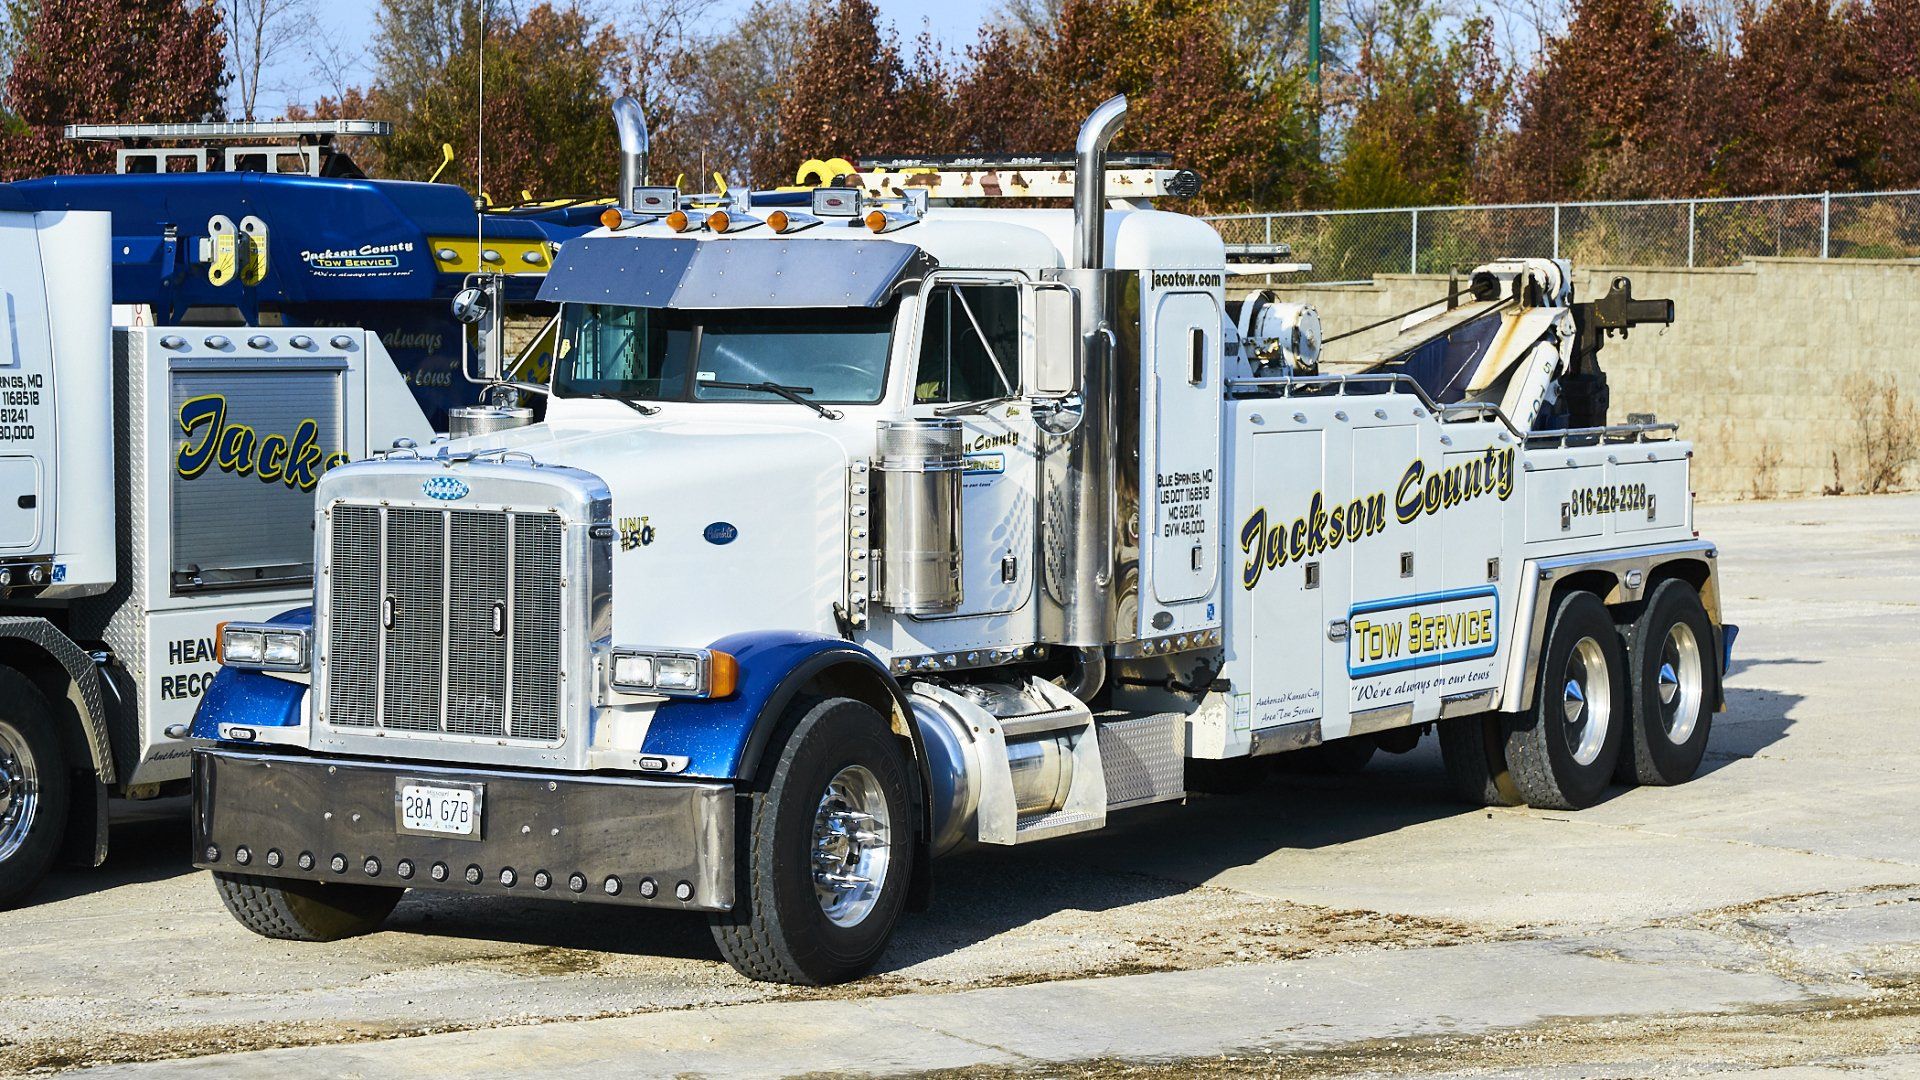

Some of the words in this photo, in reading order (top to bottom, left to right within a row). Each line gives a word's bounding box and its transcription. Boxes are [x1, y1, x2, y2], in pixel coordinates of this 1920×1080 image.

[301, 249, 358, 262] Jackson
[359, 242, 414, 255] County
[317, 258, 342, 267] TOW
[344, 258, 393, 267] SERVICE
[1151, 269, 1221, 291] jacotow.com
[383, 329, 442, 353] always
[0, 376, 27, 390] INGS,
[27, 374, 43, 388] MO
[2, 391, 40, 405] 1168518
[176, 393, 350, 493] Jacks
[974, 432, 1019, 451] County
[1157, 473, 1173, 488] BLUE
[1202, 468, 1213, 482] MO
[1160, 489, 1170, 504] US
[1170, 488, 1185, 503] DOT
[1185, 486, 1210, 501] 1168518
[1572, 482, 1647, 517] 816-228-2328
[1168, 505, 1178, 520] MC
[1179, 503, 1202, 519] 681241
[1241, 488, 1386, 591] Jackson
[1395, 445, 1515, 524] County
[619, 516, 649, 532] UNIT
[1164, 523, 1180, 537] GVW
[1180, 519, 1205, 537] 48,000
[1354, 619, 1403, 662] TOW
[1408, 608, 1492, 655] SERVICE
[169, 638, 217, 665] HEAV
[161, 672, 215, 700] RECO
[1352, 682, 1392, 701] "We're
[1394, 678, 1431, 694] always
[1433, 677, 1446, 687] on
[1448, 675, 1466, 685] our
[1255, 693, 1287, 709] Authorized
[1287, 690, 1307, 702] Kansas
[1307, 688, 1320, 700] City
[1261, 713, 1276, 724] Area
[1276, 708, 1291, 720] Tow
[1292, 706, 1315, 718] Service
[406, 796, 433, 820] 28A
[441, 799, 469, 823] G7B
